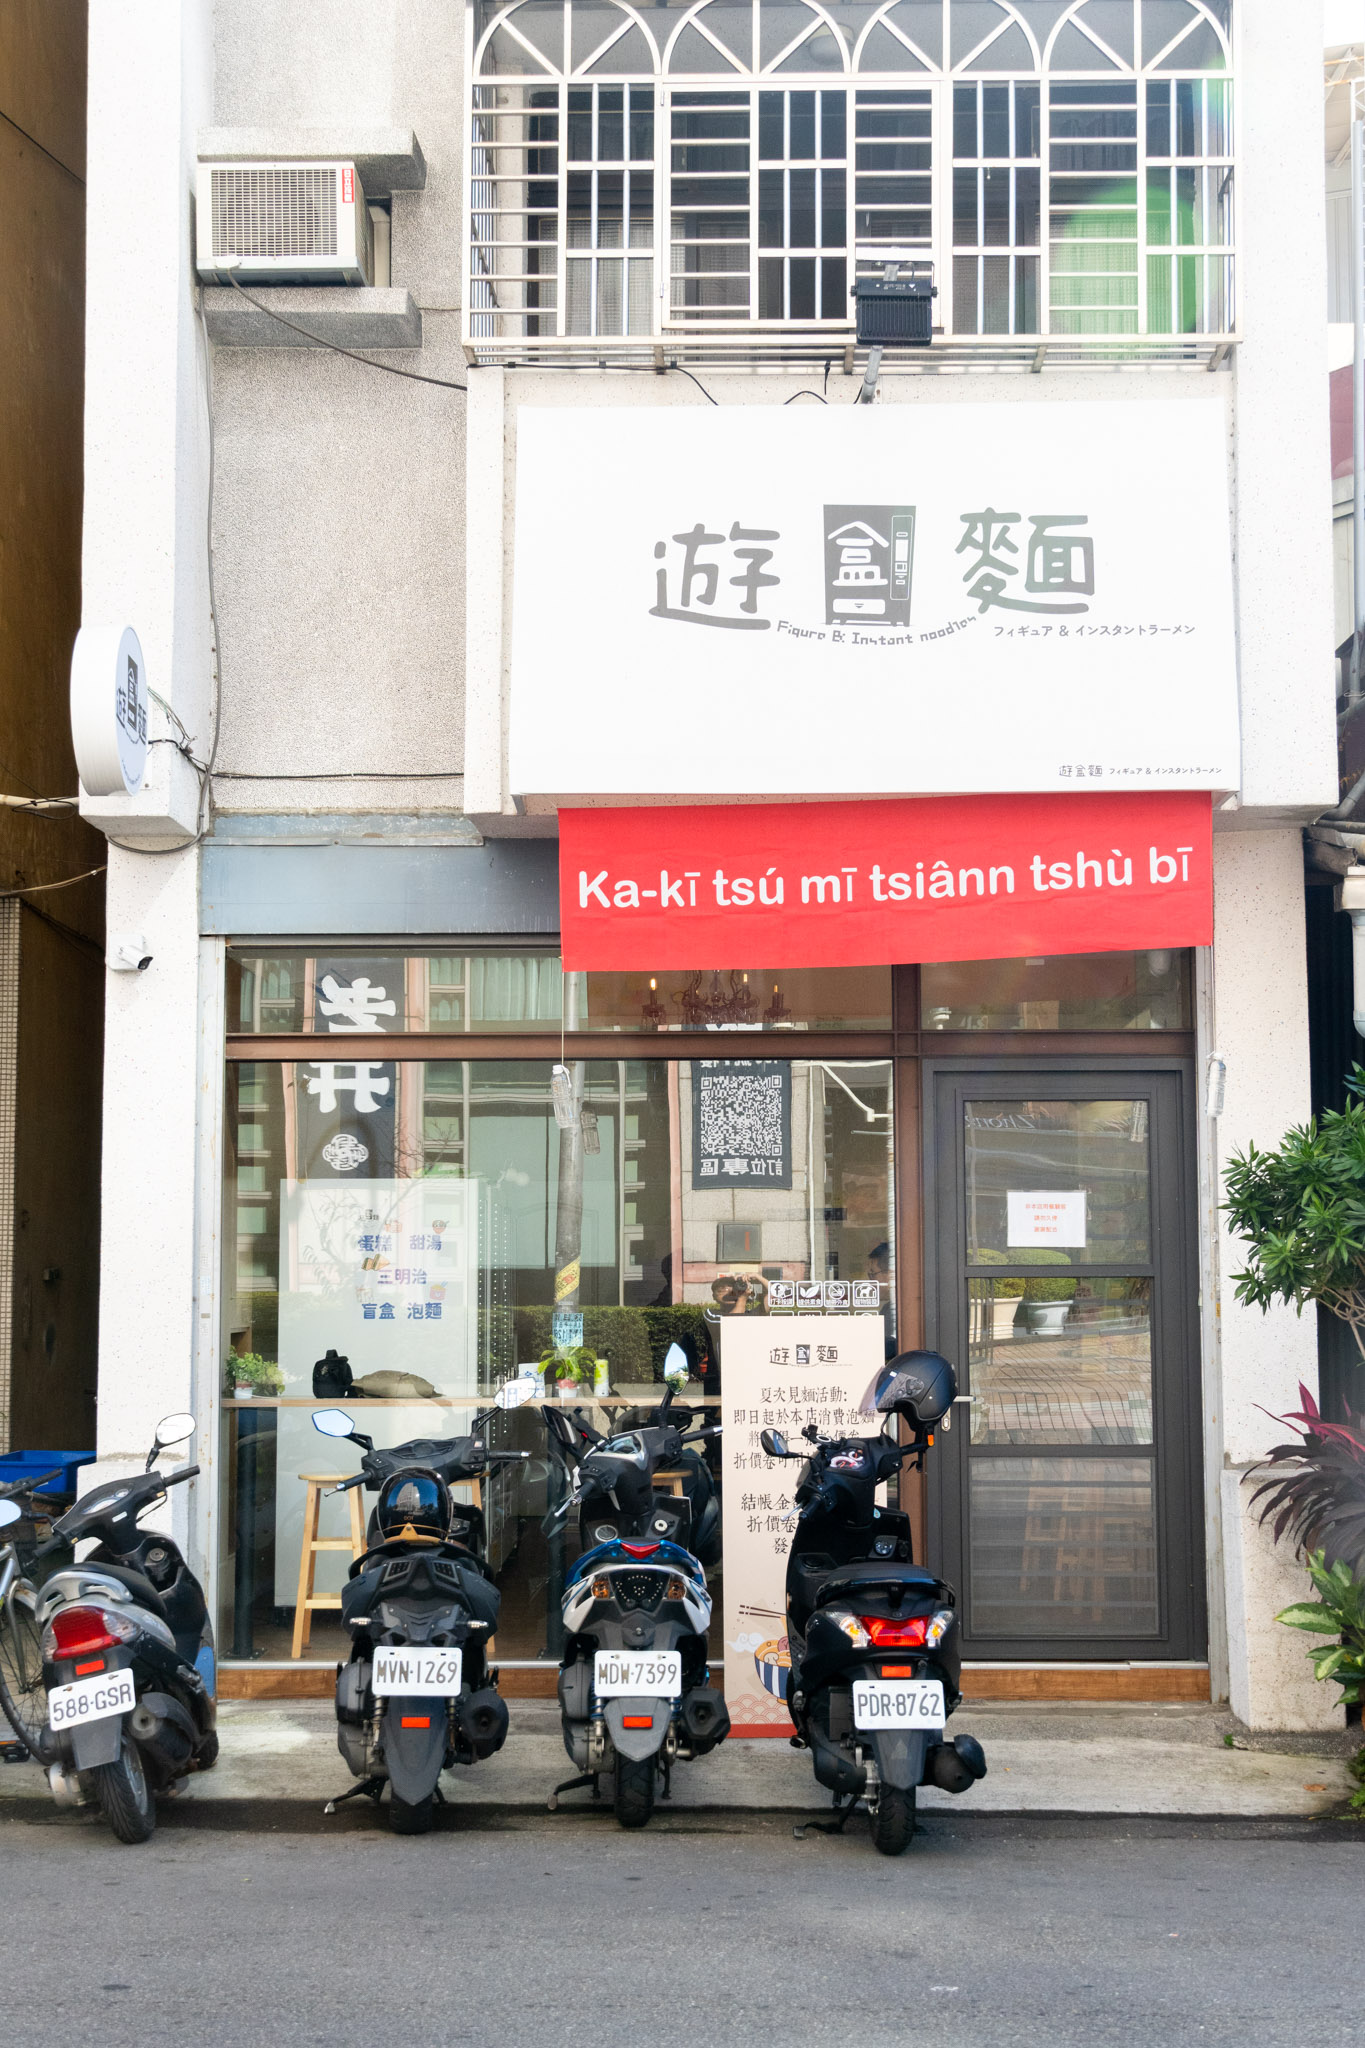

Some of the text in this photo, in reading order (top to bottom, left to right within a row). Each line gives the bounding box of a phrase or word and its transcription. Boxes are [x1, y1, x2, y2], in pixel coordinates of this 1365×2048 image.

[648, 506, 1095, 630] 遊盒麵
[994, 624, 1196, 637] フィギュア & インスタントラーメン
[1058, 764, 1103, 778] 遊盒麵
[1108, 767, 1143, 775] フィギュア
[1154, 766, 1222, 775] インスタントラーメン
[578, 847, 1193, 909] Ka-kī tsú mī tsiânn tshù bī
[357, 1234, 442, 1252] 蛋糕 甜湯
[377, 1267, 427, 1285] 三明治
[362, 1302, 442, 1320] 盲盒 泡麵
[770, 1344, 838, 1365] 遊盒麵
[733, 1407, 876, 1425] 即日起於本店消費泡麵
